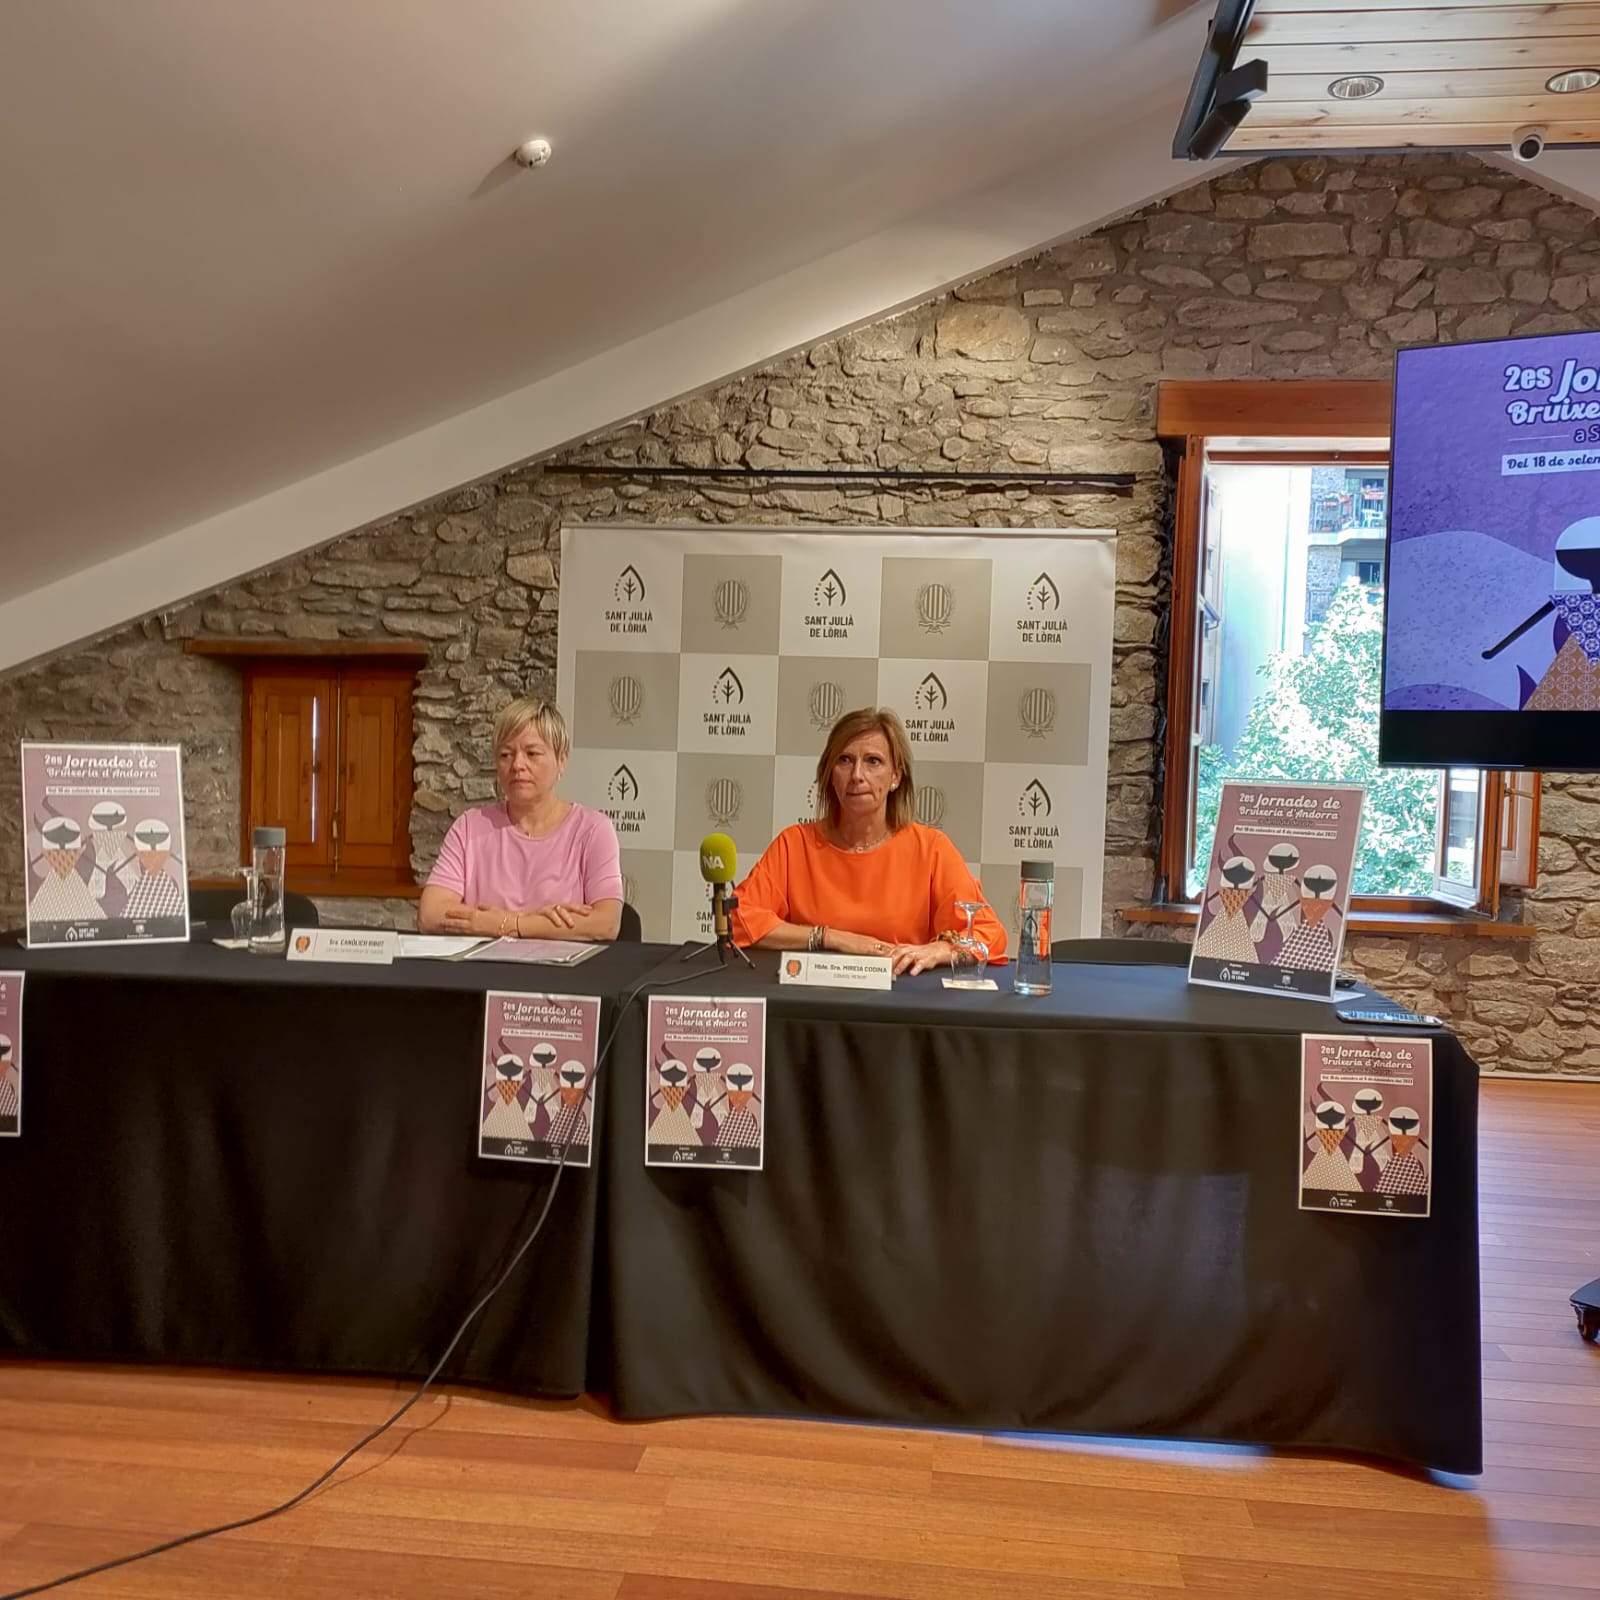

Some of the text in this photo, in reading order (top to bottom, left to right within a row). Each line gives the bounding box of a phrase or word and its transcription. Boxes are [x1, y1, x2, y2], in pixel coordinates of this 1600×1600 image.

[1504, 359, 1600, 403] 2es Jo
[1575, 429, 1586, 442] a
[1507, 458, 1528, 469] Del
[1533, 456, 1546, 467] 18
[1548, 456, 1565, 467] de
[605, 609, 653, 621] SANT JULIÀ
[804, 614, 854, 626] SANT JULIÀ
[610, 623, 621, 633] DE
[1017, 619, 1068, 631] SANT JULIÀ
[810, 627, 848, 638] DE LÒRIA
[1022, 631, 1061, 643] DE LÒRIA
[703, 713, 725, 723] SANT
[905, 718, 955, 730] SANT JULIÀ
[708, 725, 719, 735] DE
[910, 730, 949, 742] DE LÒRIA
[64, 754, 133, 768] Jornades
[139, 756, 158, 768] de
[1254, 793, 1318, 808] Jornades
[1323, 797, 1342, 809] de
[622, 809, 646, 820] JULIÀ
[1239, 806, 1339, 820] Bruixeria d'Andorra
[1009, 825, 1059, 837] SANT JULIÀ
[1014, 837, 1053, 849] DE LÒRIA
[701, 924, 712, 933] DE
[516, 1002, 567, 1015] Jornades
[570, 1005, 583, 1017] de
[678, 1006, 730, 1019] Jornades
[733, 1007, 748, 1019] de
[1335, 1046, 1392, 1059] Jornades
[1397, 1049, 1413, 1060] de
